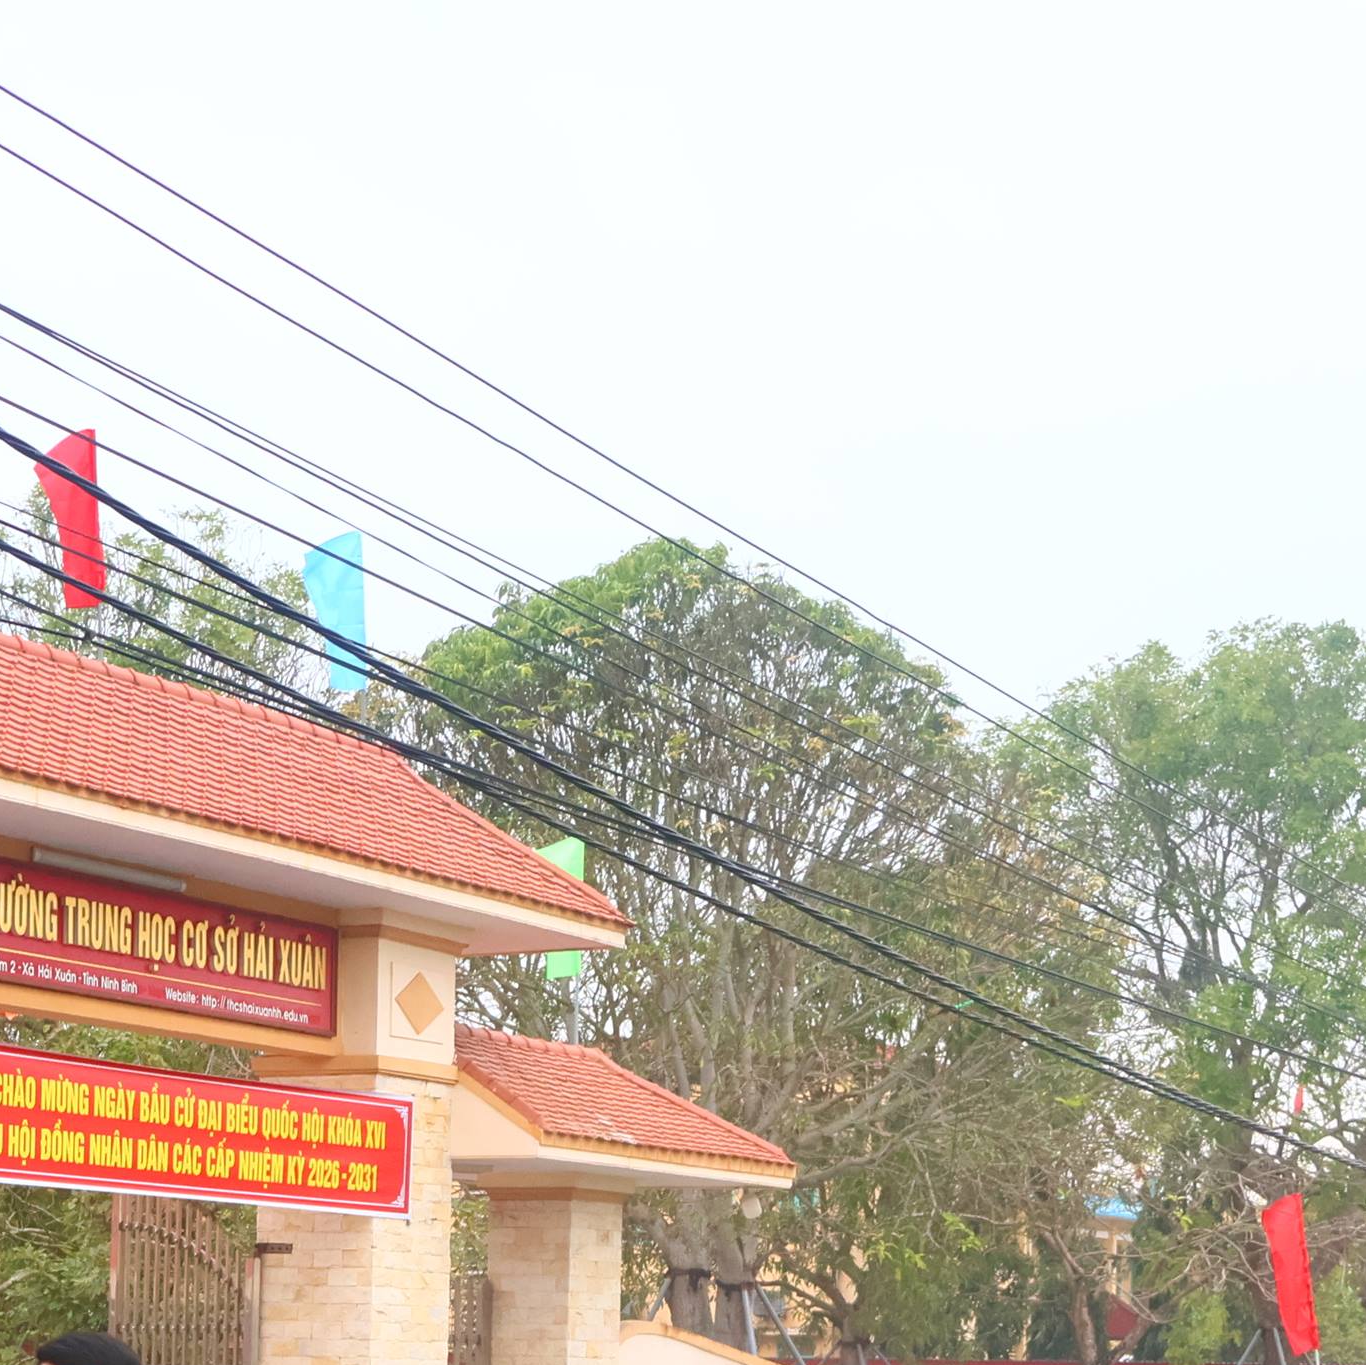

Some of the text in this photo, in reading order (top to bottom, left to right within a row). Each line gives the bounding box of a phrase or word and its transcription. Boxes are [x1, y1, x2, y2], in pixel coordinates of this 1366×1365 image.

[64, 895, 133, 955] TRUNG
[138, 911, 176, 972] HỌC
[182, 919, 209, 969] CƠ
[213, 914, 240, 975] SỞ
[243, 921, 274, 982] HẢI
[278, 934, 326, 990] XUÂN
[55, 968, 76, 983] Xuân
[101, 975, 119, 991] Ninh
[165, 986, 199, 1004] Website:
[41, 1074, 90, 1115] MỪNG
[93, 1082, 136, 1121] NGÀY
[139, 1083, 170, 1126] BẦU
[174, 1088, 195, 1129] CỬ
[197, 1098, 222, 1137] ĐẠI
[226, 1093, 258, 1136] BIỂU
[261, 1100, 299, 1140] QUỐC
[302, 1107, 325, 1149] HỘI
[327, 1112, 362, 1148] KHÓA
[365, 1121, 387, 1150] XVI
[8, 1119, 36, 1166] HỘI
[40, 1119, 85, 1165] ĐỒNG
[89, 1130, 133, 1169] NHÂN
[137, 1133, 169, 1173] DÂN
[172, 1137, 202, 1176] CÁC
[206, 1137, 235, 1178] CẤP
[238, 1147, 284, 1189] NHIỆM
[287, 1151, 306, 1186] KỲ
